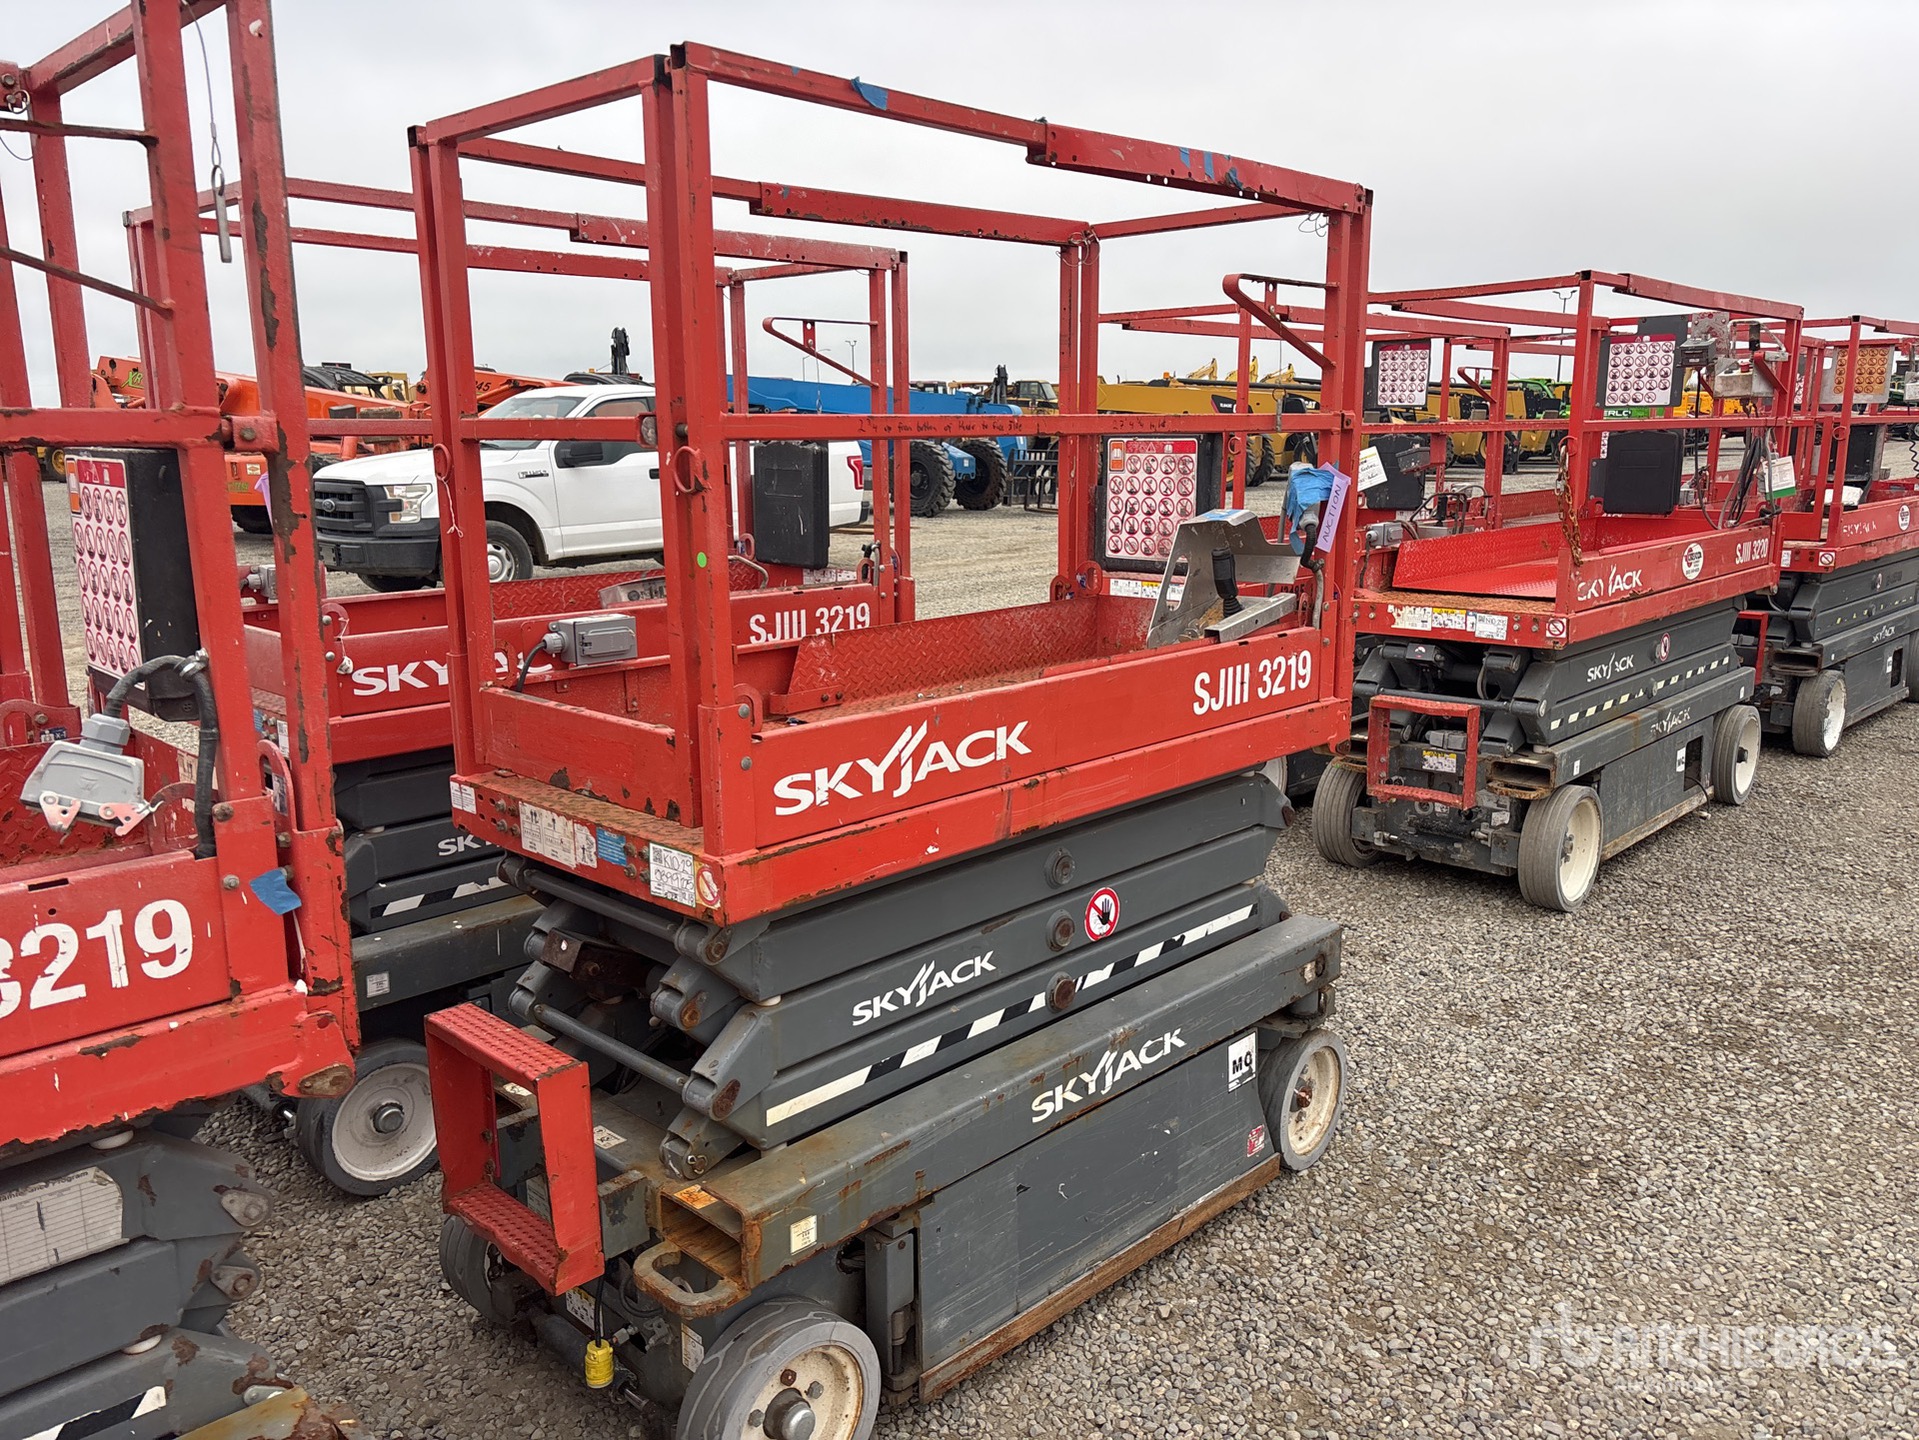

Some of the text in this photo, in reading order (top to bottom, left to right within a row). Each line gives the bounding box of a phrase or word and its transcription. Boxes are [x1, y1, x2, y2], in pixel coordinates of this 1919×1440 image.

[475, 381, 491, 392] 45
[1323, 484, 1342, 544] AUCTION
[749, 602, 871, 644] SJIII 3219
[1193, 650, 1312, 716] SJIII 3219
[773, 720, 1032, 816] SKYJACK
[852, 949, 997, 1027] SKYJACK
[1031, 1026, 1187, 1124] SKYJACK
